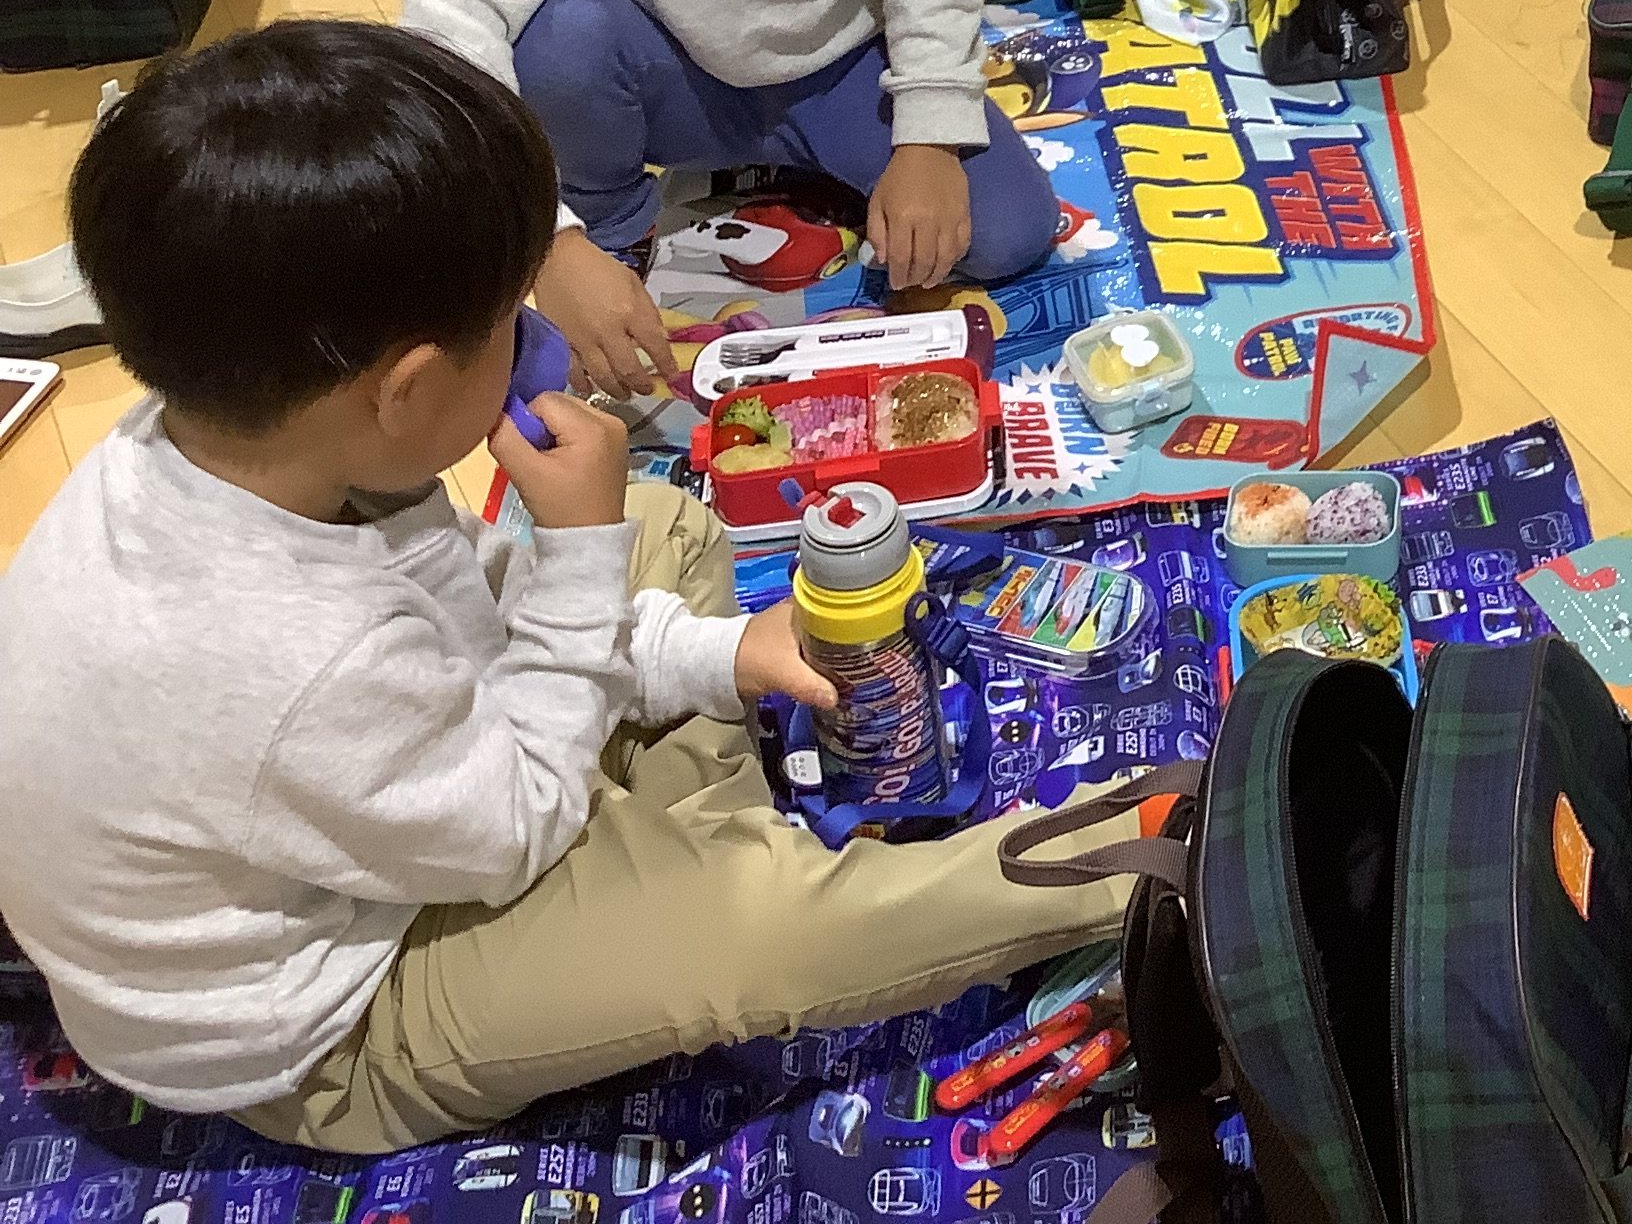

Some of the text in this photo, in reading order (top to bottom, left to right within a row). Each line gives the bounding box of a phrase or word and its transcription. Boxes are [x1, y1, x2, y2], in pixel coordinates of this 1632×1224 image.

[1264, 172, 1337, 248] THE
[1309, 145, 1393, 249] WITH
[1258, 331, 1287, 376] PATROL
[1006, 400, 1060, 483] BRAVE
[1450, 462, 1466, 491] E235
[1103, 518, 1115, 533] E3
[1172, 583, 1183, 604] E235
[1487, 592, 1499, 606] E7
[997, 661, 1008, 673] E7
[893, 711, 926, 761] GO!
[1125, 731, 1138, 754] E257
[908, 1015, 925, 1056] E235
[633, 1092, 649, 1126] E233
[548, 1143, 565, 1184] E257
